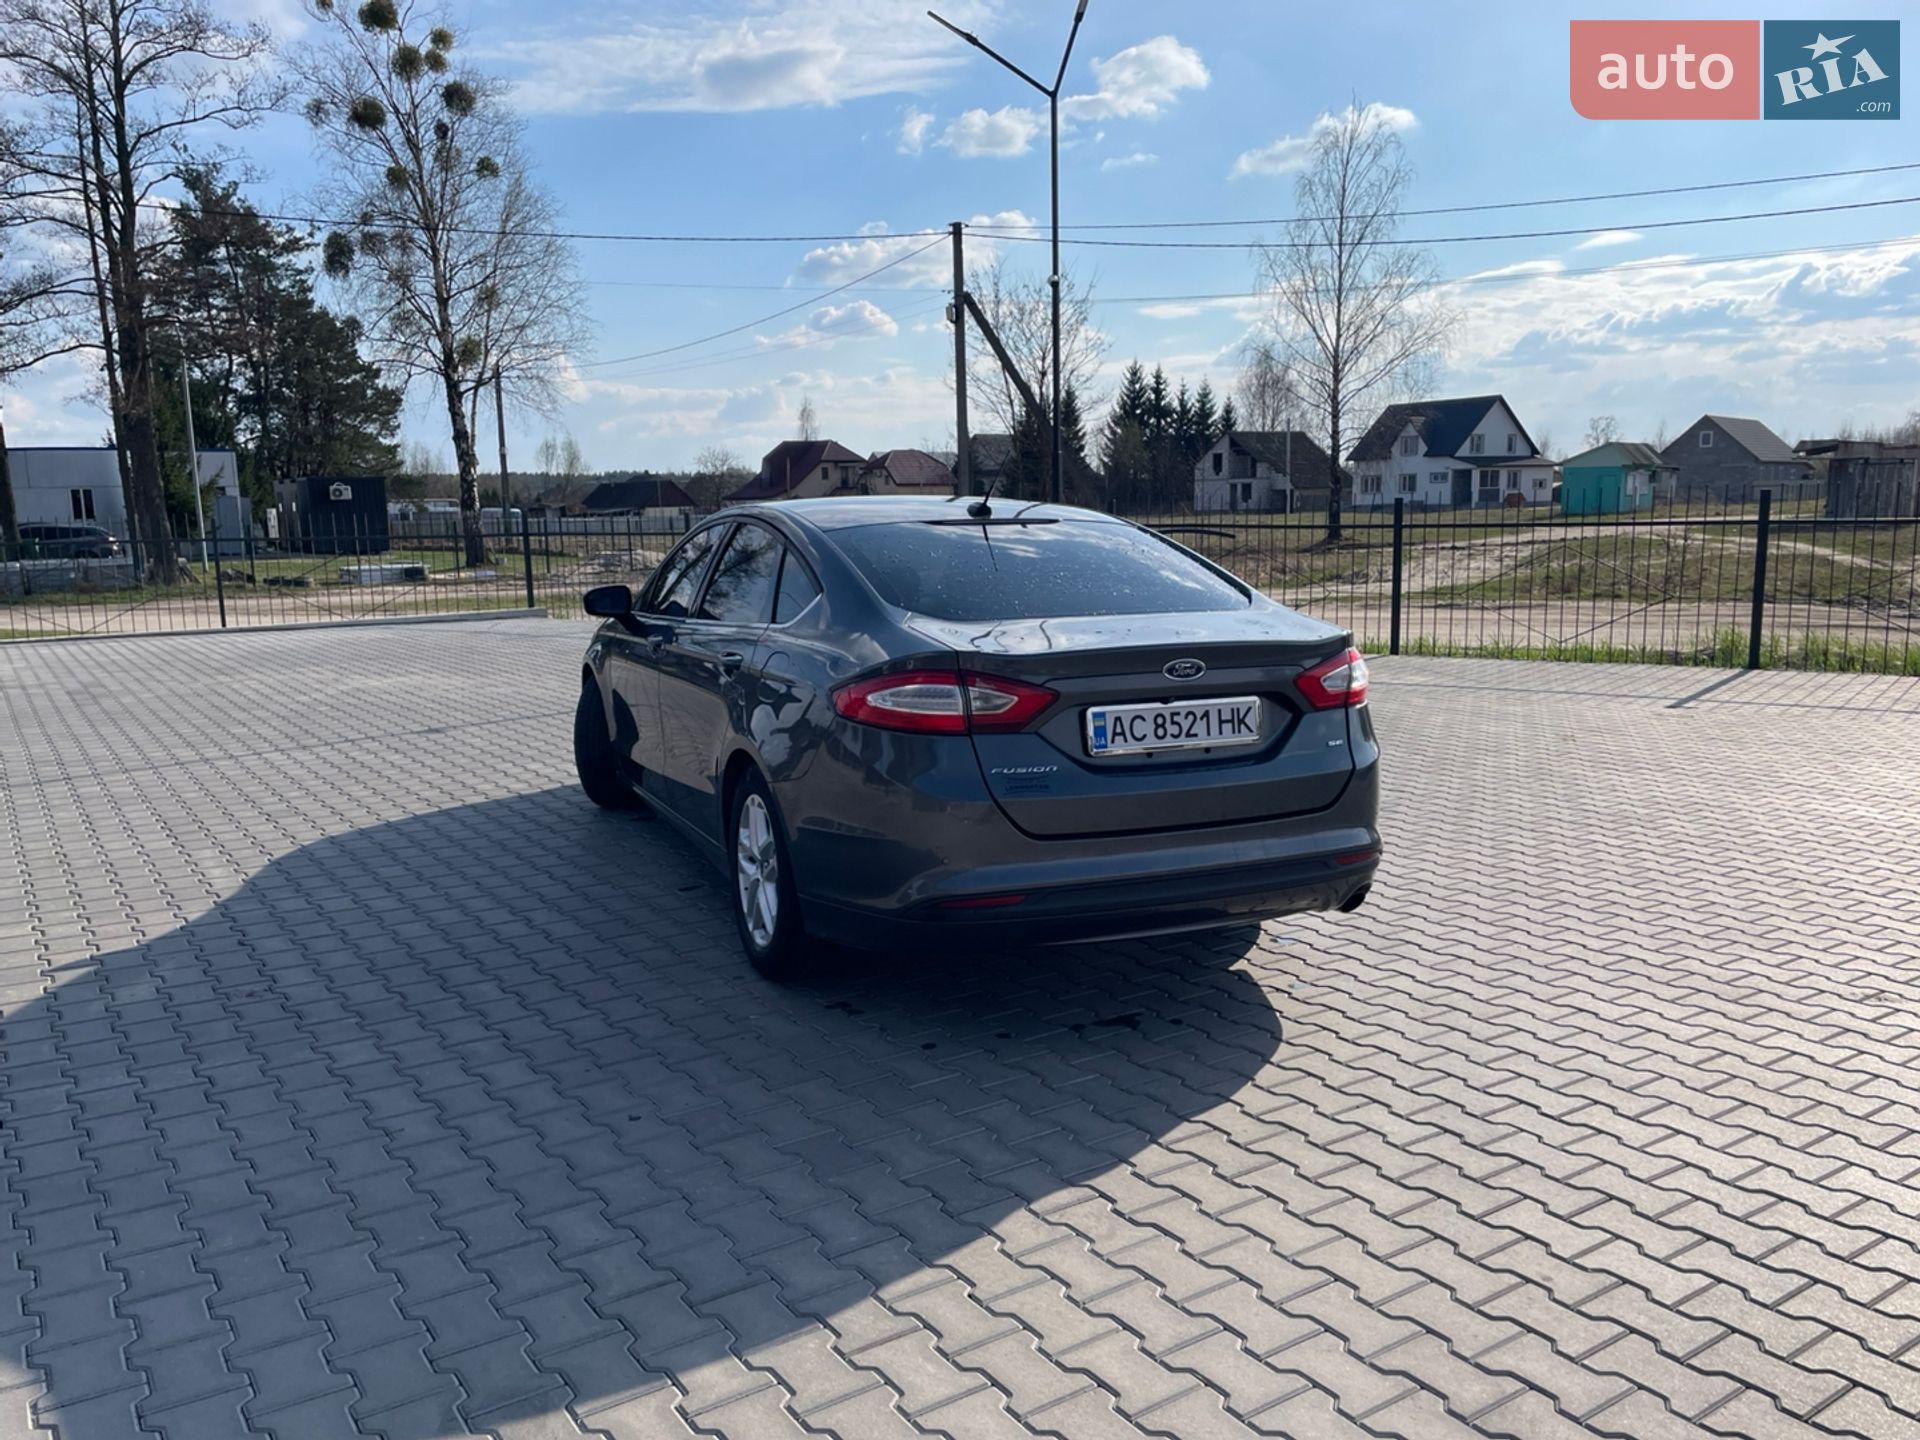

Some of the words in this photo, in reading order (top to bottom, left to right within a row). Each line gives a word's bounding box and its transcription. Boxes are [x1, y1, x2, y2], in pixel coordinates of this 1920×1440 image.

[1173, 662, 1198, 676] Ford
[1110, 714, 1148, 744] AC
[1153, 709, 1211, 740] 8521
[1217, 706, 1254, 736] HK
[1094, 736, 1107, 747] UA
[991, 765, 1059, 774] FUSION
